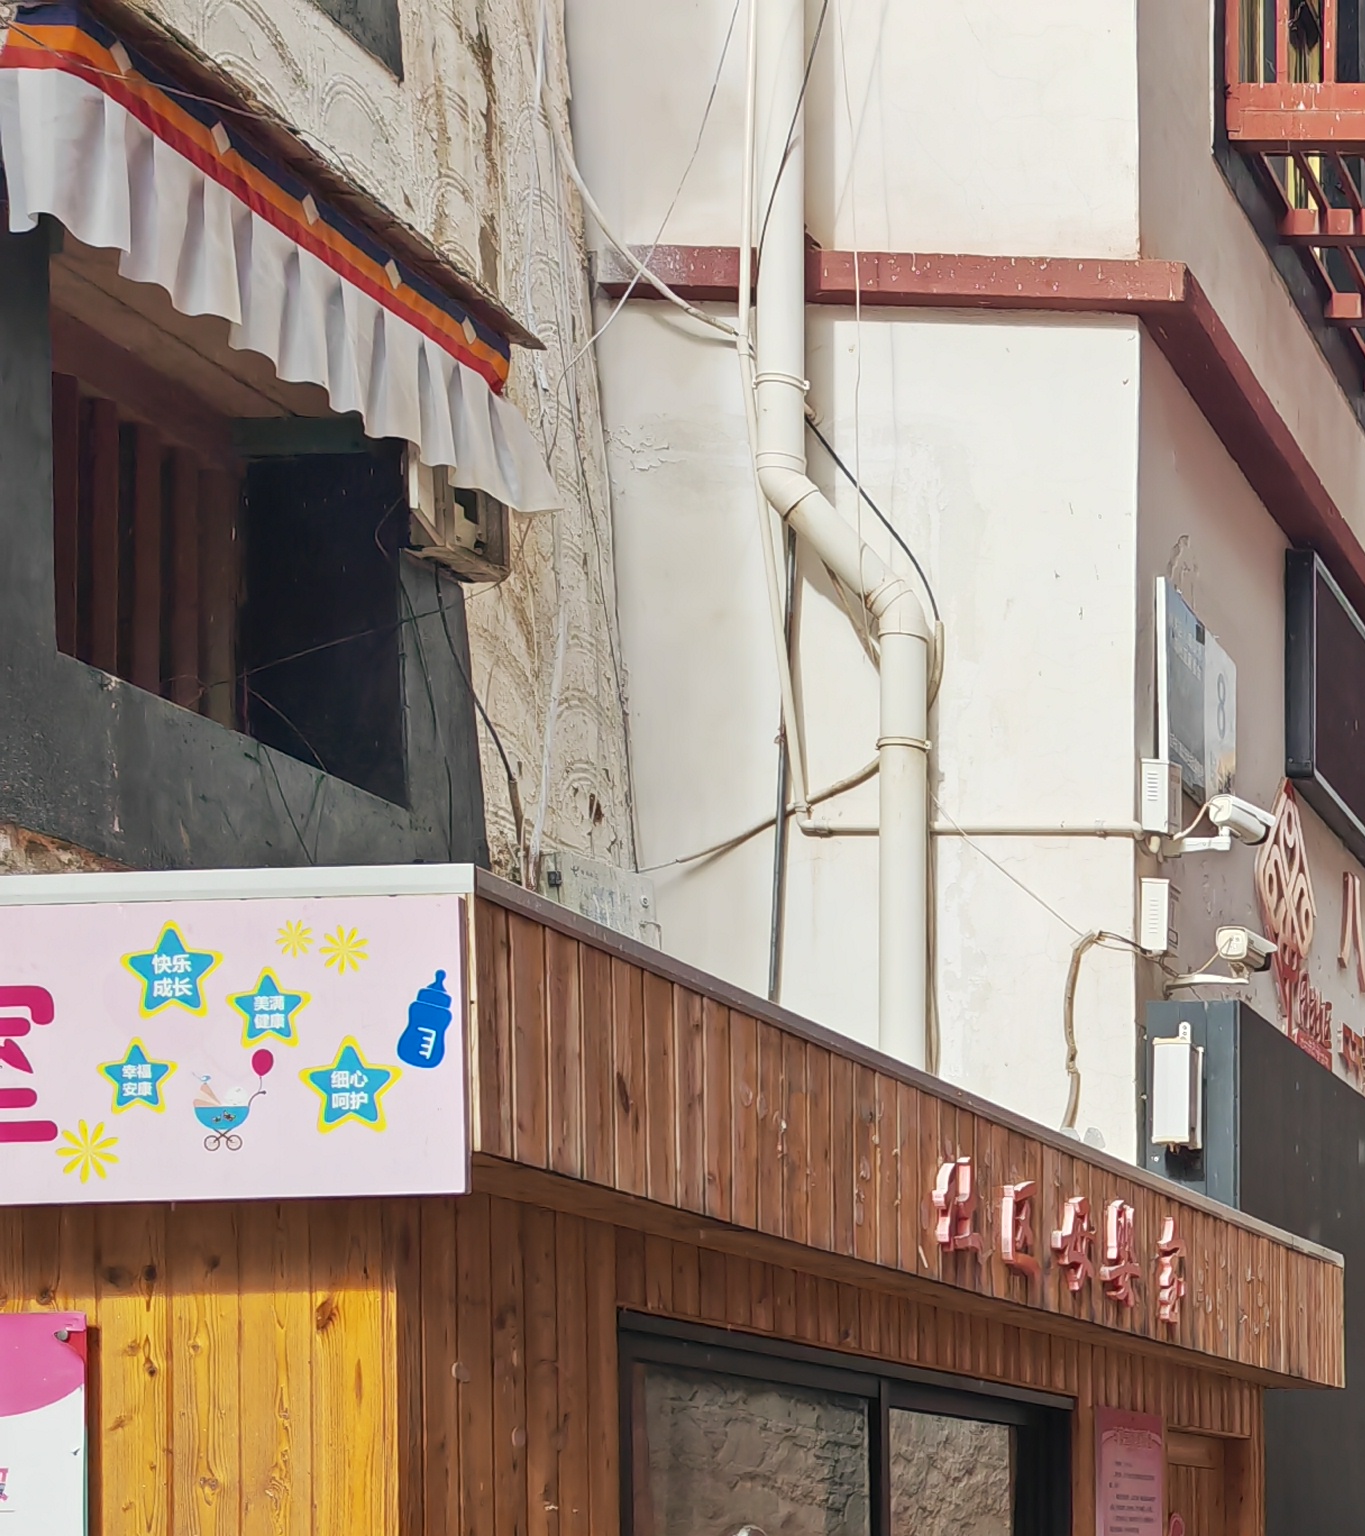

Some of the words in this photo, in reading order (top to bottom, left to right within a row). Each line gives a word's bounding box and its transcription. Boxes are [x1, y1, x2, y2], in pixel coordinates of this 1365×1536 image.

[152, 954, 192, 974] 快乐
[153, 977, 193, 998] 成长
[254, 995, 285, 1012] 美满
[254, 1013, 285, 1029] 健康
[121, 1064, 152, 1079] 幸福
[331, 1070, 368, 1089] 细心
[122, 1081, 153, 1098] 安康
[331, 1092, 368, 1111] 呵护
[932, 1156, 1187, 1325] 社区母婴室
